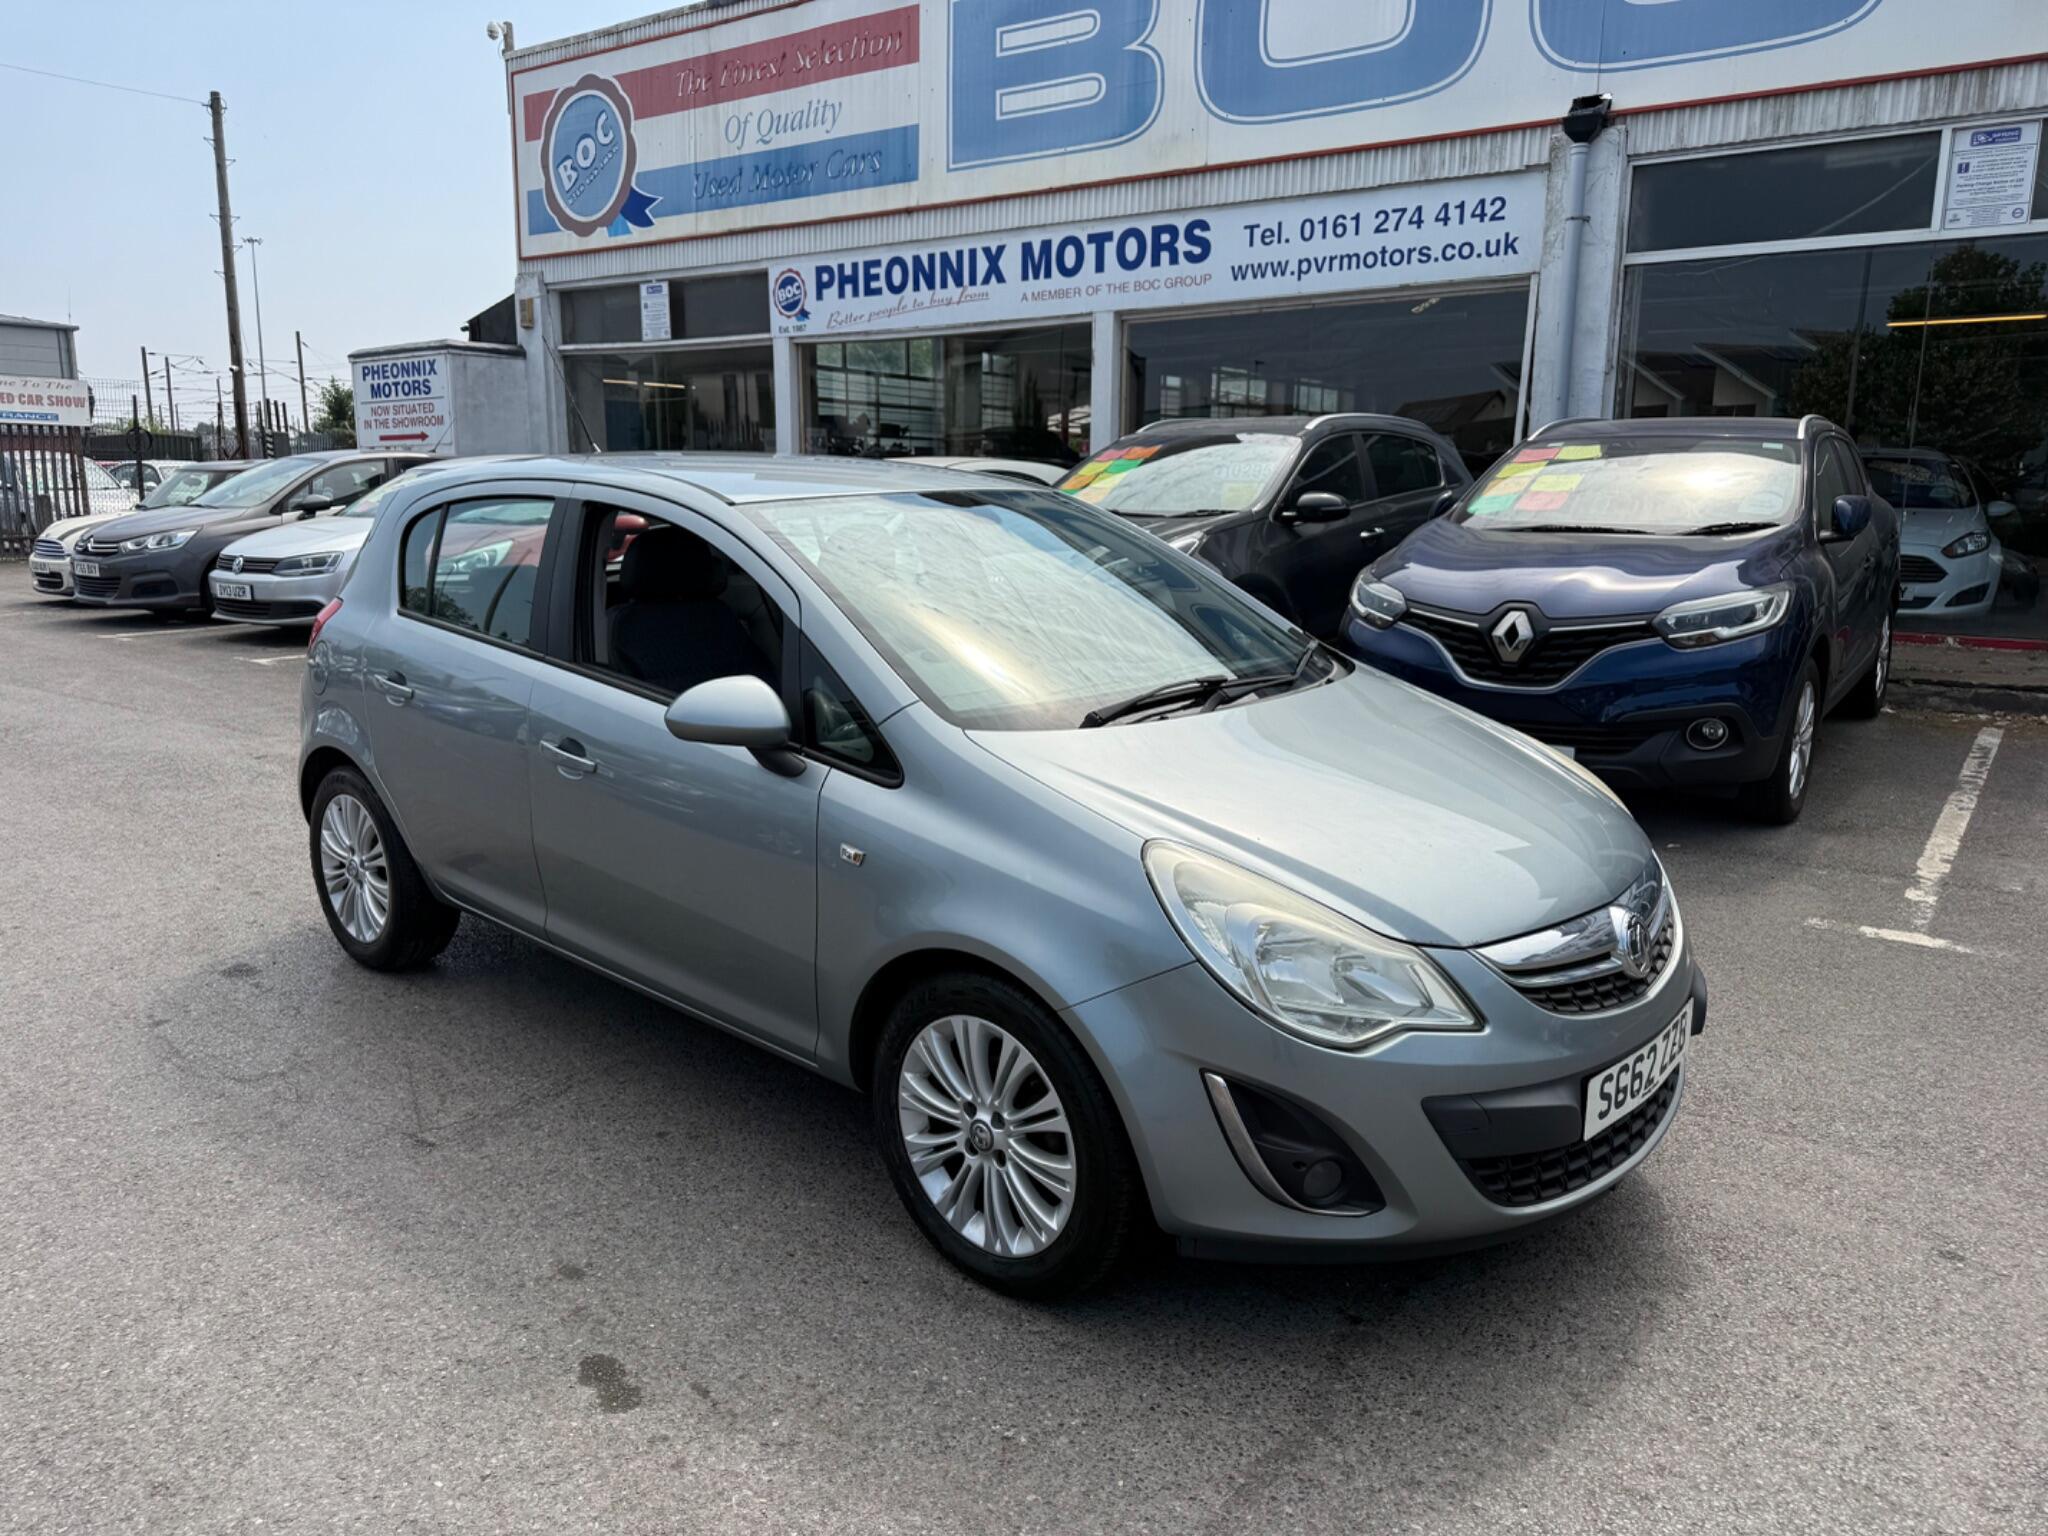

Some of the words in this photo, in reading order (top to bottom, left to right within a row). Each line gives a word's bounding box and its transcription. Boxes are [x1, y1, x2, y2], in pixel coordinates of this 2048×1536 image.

[675, 66, 712, 97] The
[719, 52, 787, 89] Finest
[792, 30, 903, 75] Selection
[724, 111, 753, 150] Of
[756, 98, 843, 145] Quality
[557, 109, 615, 193] BOC
[693, 165, 743, 201] Used
[750, 157, 819, 193] Motor
[825, 148, 883, 180] Cars
[1243, 220, 1291, 248] Tel.
[1299, 212, 1361, 242] 0161
[1373, 205, 1425, 234] 274
[1434, 196, 1507, 227] 4142
[815, 244, 1007, 301] PHEONNIX
[1020, 218, 1212, 281] MOTORS
[1230, 231, 1520, 281] www.pvrmotors.co.uk
[777, 281, 802, 301] BOC
[826, 310, 864, 330] Better
[868, 295, 909, 323] people
[912, 297, 925, 310] to
[929, 291, 954, 308] buy
[955, 285, 990, 305] from
[1020, 292, 1028, 302] A
[1030, 287, 1082, 301] MEMBER
[1085, 284, 1102, 297] OF
[1106, 282, 1130, 294] THE
[1133, 279, 1161, 292] BOC
[1164, 273, 1213, 289] GROUP
[44, 381, 73, 390] The
[362, 358, 438, 382] PHEONNIX
[370, 378, 432, 399] MOTORS
[18, 393, 44, 406] CAR
[47, 395, 86, 408] SHOW
[364, 419, 372, 430] IN
[374, 418, 391, 430] THE
[392, 415, 444, 429] SHOWROOM
[370, 405, 391, 417] NOW
[392, 402, 435, 416] SITUATED
[1597, 1043, 1658, 1121] SG62
